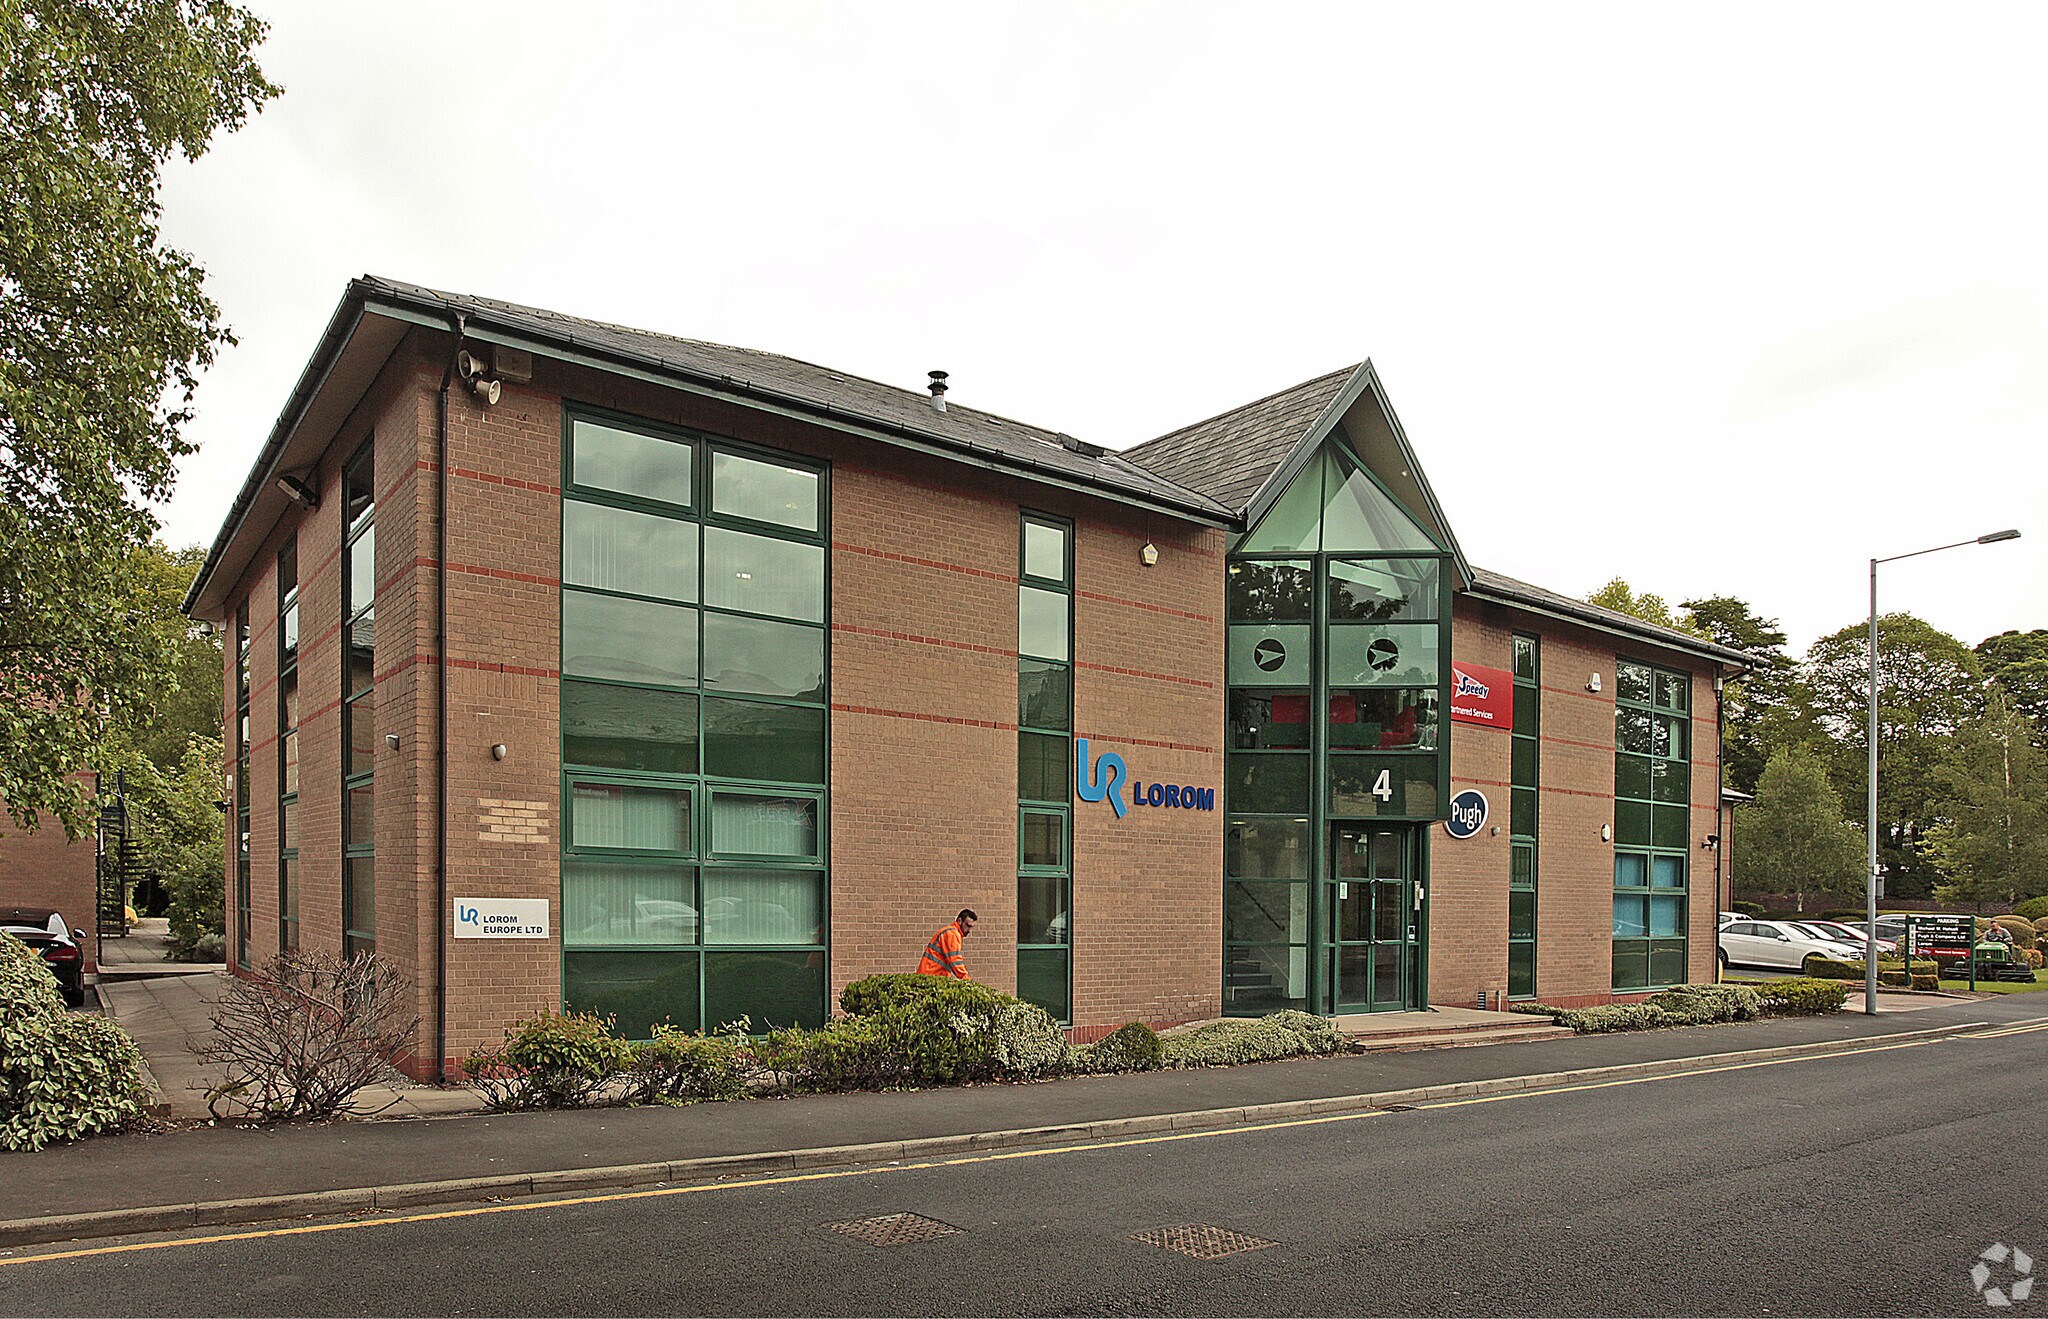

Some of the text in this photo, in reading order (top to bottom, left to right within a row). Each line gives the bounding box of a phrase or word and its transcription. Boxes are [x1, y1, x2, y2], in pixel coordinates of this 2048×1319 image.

[1459, 676, 1488, 698] Speedy
[1451, 705, 1494, 719] artnered Services
[1134, 781, 1214, 811] LOROM
[1372, 769, 1392, 802] 4
[1452, 802, 1482, 830] Pugh
[483, 915, 518, 923] LOROM
[483, 926, 543, 934] EUROPE LTD
